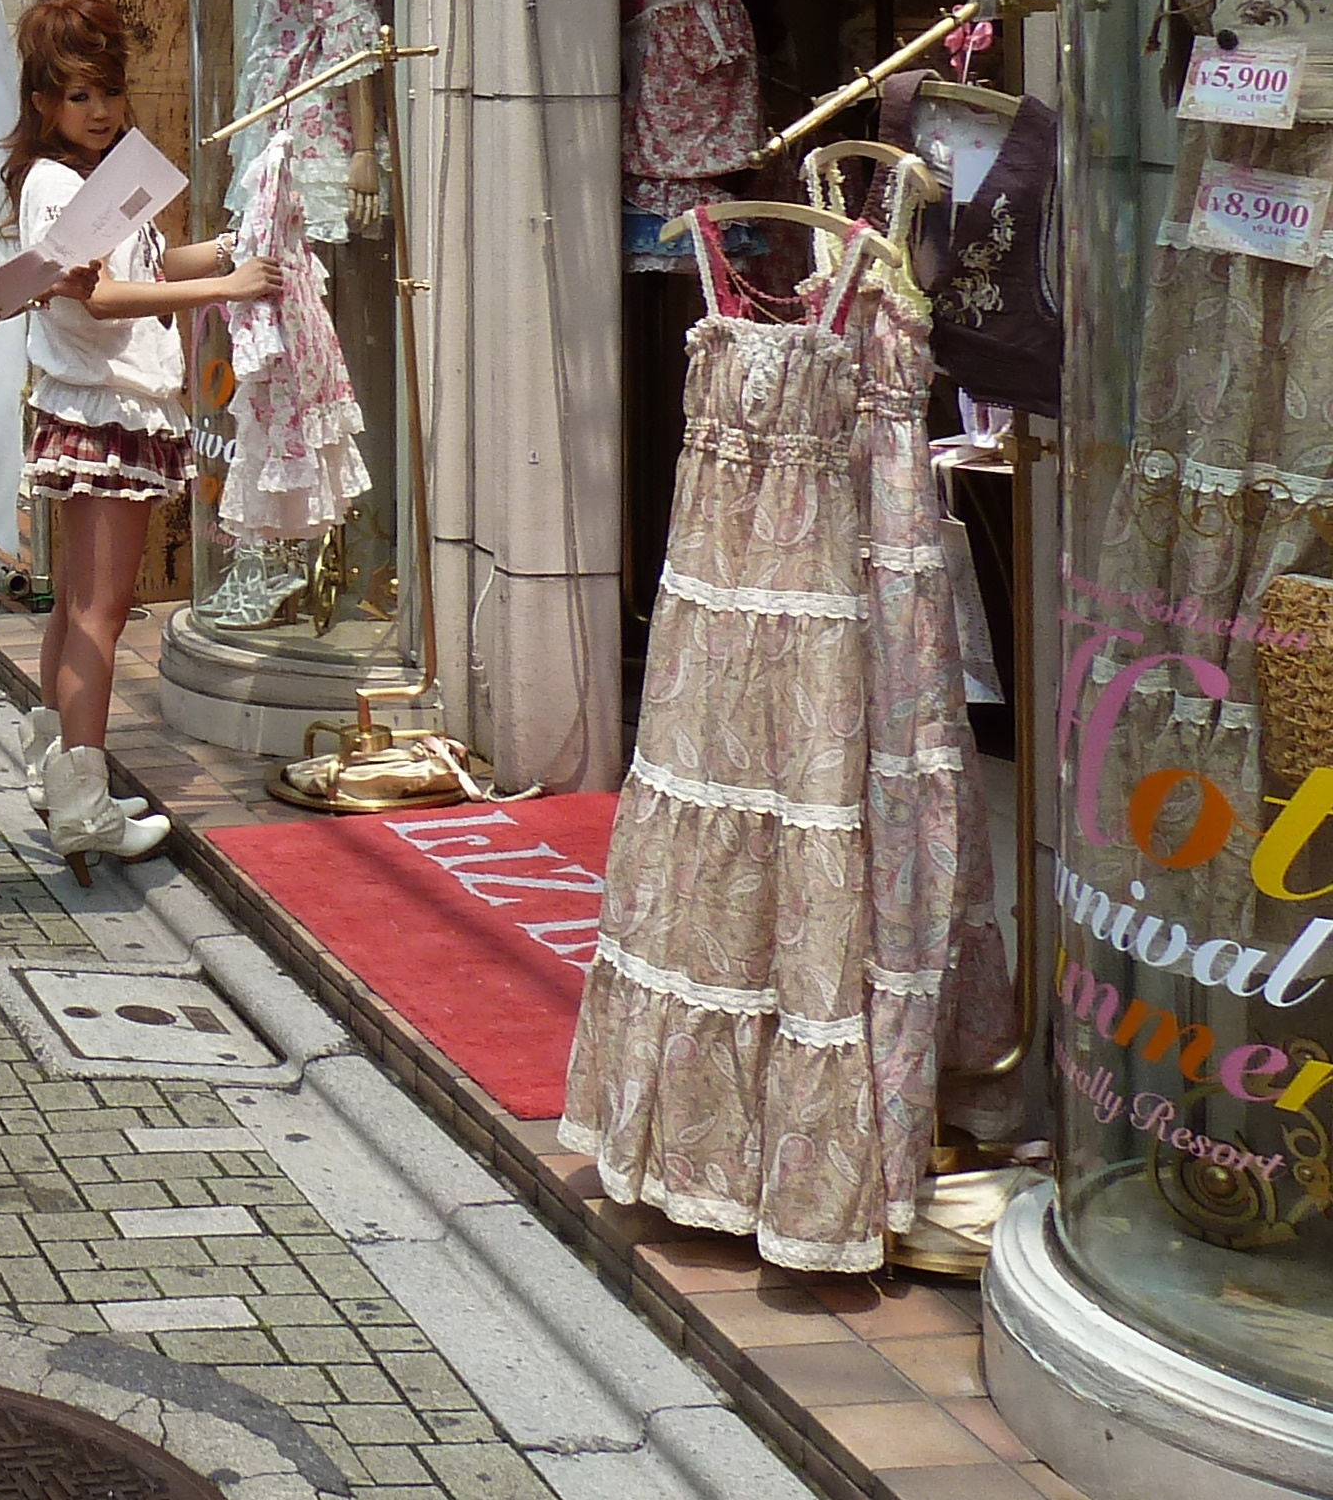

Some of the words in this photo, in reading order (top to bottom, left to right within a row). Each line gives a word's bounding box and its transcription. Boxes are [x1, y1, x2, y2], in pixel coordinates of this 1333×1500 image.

[1200, 65, 1288, 93] ¥5,900
[1211, 192, 1309, 228] ¥8,900
[383, 809, 606, 907] LIZ
[1130, 1093, 1287, 1182] Resort
